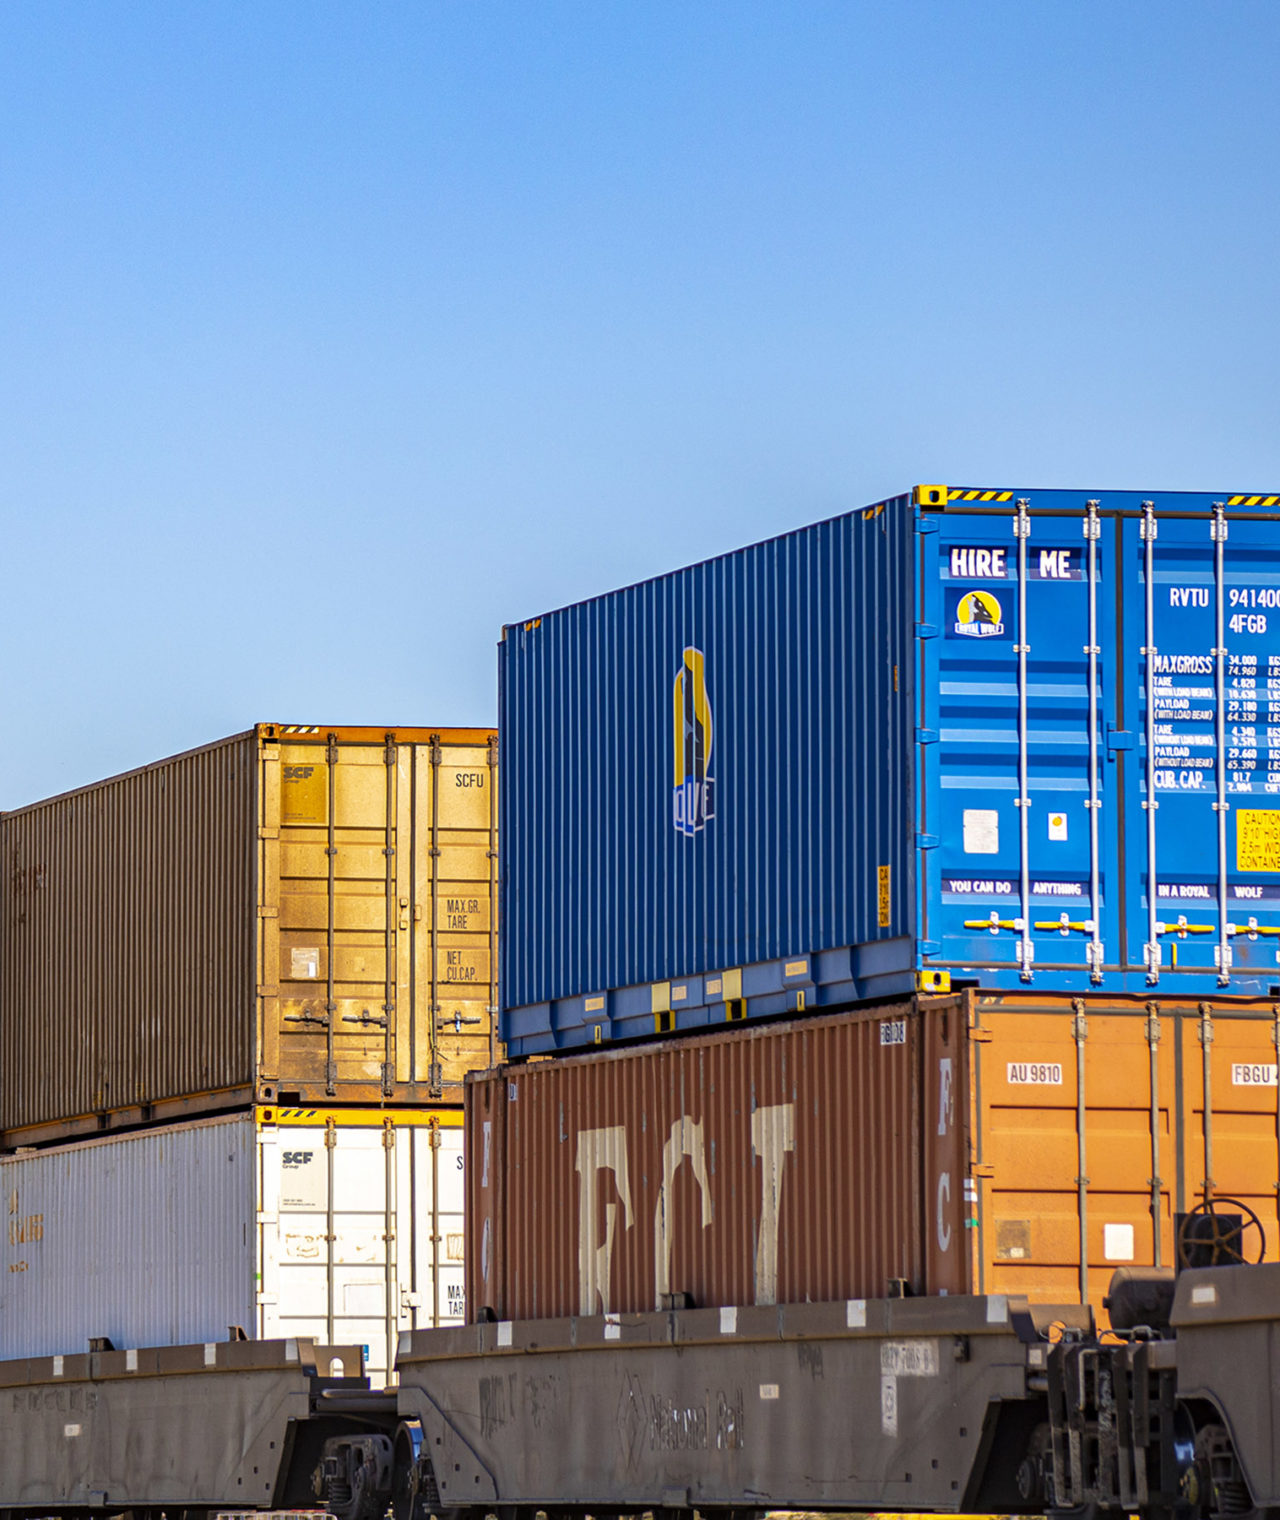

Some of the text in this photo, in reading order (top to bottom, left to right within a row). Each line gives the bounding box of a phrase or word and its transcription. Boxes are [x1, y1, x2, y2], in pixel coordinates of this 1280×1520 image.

[951, 548, 1072, 578] HIRE ME
[1170, 587, 1209, 607] RVTU
[1229, 614, 1267, 634] 4FGB
[1153, 655, 1213, 674] MAXGROSS
[1153, 676, 1173, 687] TARE
[1154, 699, 1189, 709] PAYLOAD
[1154, 724, 1173, 734] TARE
[1154, 747, 1190, 757] PAYLOAD
[283, 766, 314, 778] SCF
[1179, 770, 1207, 789] CAP.
[455, 773, 484, 788] SCFU
[950, 880, 1263, 898] YOU CAN DO ANYTHING IN A ROYAL WOLF
[447, 915, 468, 929] TARE
[447, 951, 461, 965] NET
[1010, 1064, 1061, 1083] AU 9810
[1235, 1065, 1270, 1083] FBGU
[282, 1151, 313, 1164] SCF
